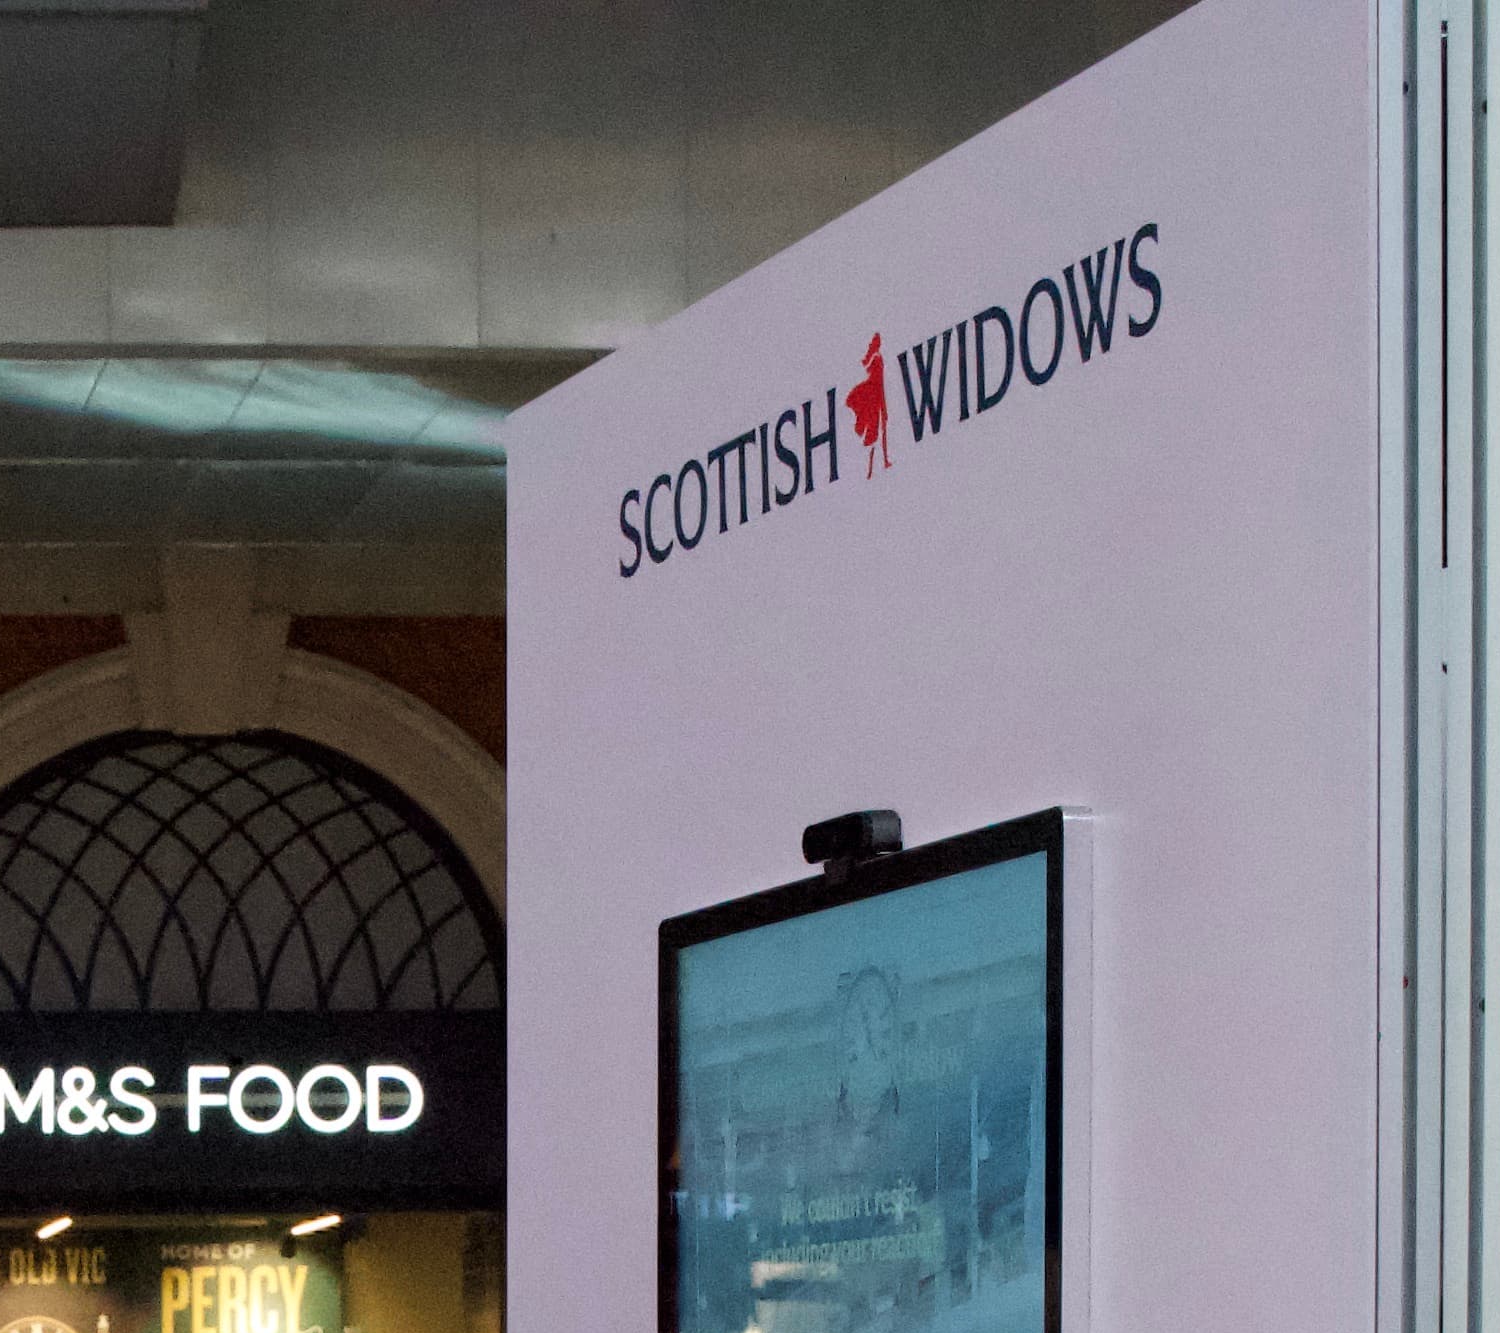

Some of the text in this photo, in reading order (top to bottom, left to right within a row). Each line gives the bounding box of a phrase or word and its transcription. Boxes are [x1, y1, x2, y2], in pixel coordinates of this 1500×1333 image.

[618, 222, 1162, 579] SCOTTISH WIDOWS
[186, 1064, 425, 1135] FOOD
[9, 1247, 57, 1285] OLD
[65, 1246, 107, 1285] VIC
[227, 1242, 256, 1260] OF
